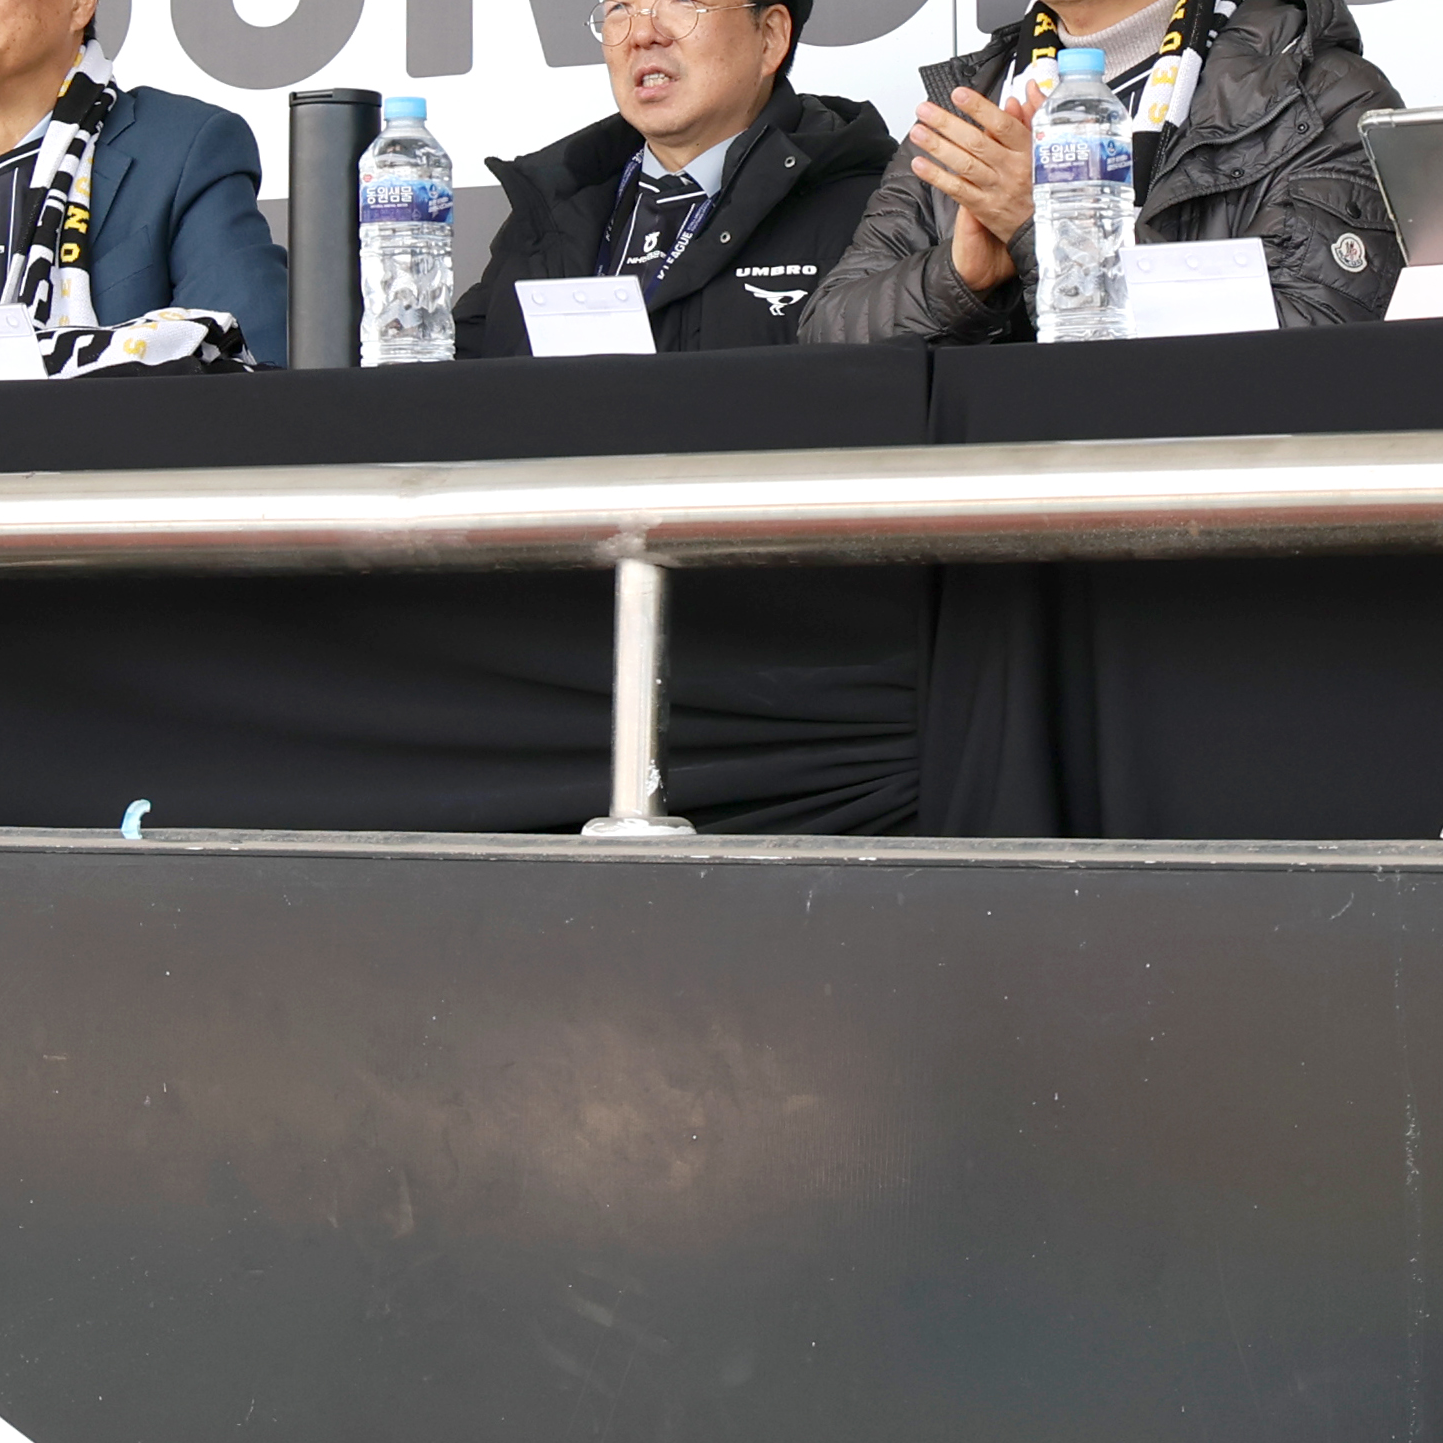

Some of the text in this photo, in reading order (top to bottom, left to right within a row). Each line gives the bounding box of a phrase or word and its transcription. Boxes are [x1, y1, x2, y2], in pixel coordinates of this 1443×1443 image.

[1039, 143, 1090, 164] 동원샘물
[367, 186, 413, 204] 동원샘물
[736, 265, 817, 277] UMBRO
